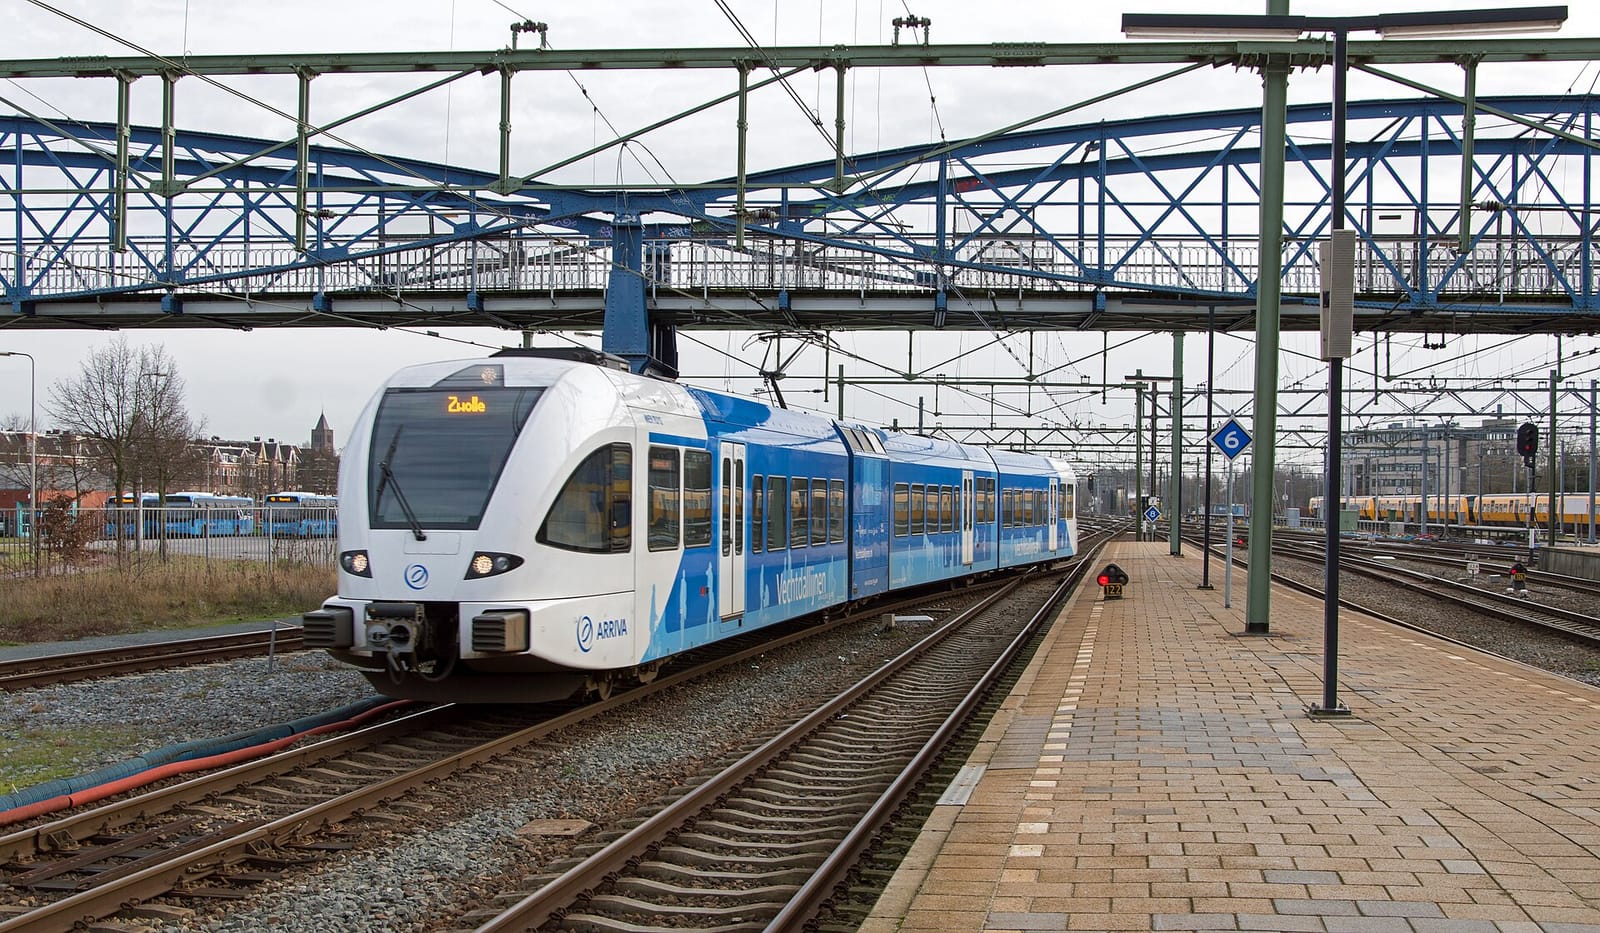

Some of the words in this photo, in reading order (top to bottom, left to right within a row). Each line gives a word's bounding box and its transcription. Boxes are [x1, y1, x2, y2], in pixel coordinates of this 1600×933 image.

[447, 395, 486, 413] Zwolle
[1224, 430, 1240, 449] 6
[1149, 510, 1156, 518] 8
[1106, 585, 1121, 595] 122
[596, 618, 628, 641] ARRIVA
